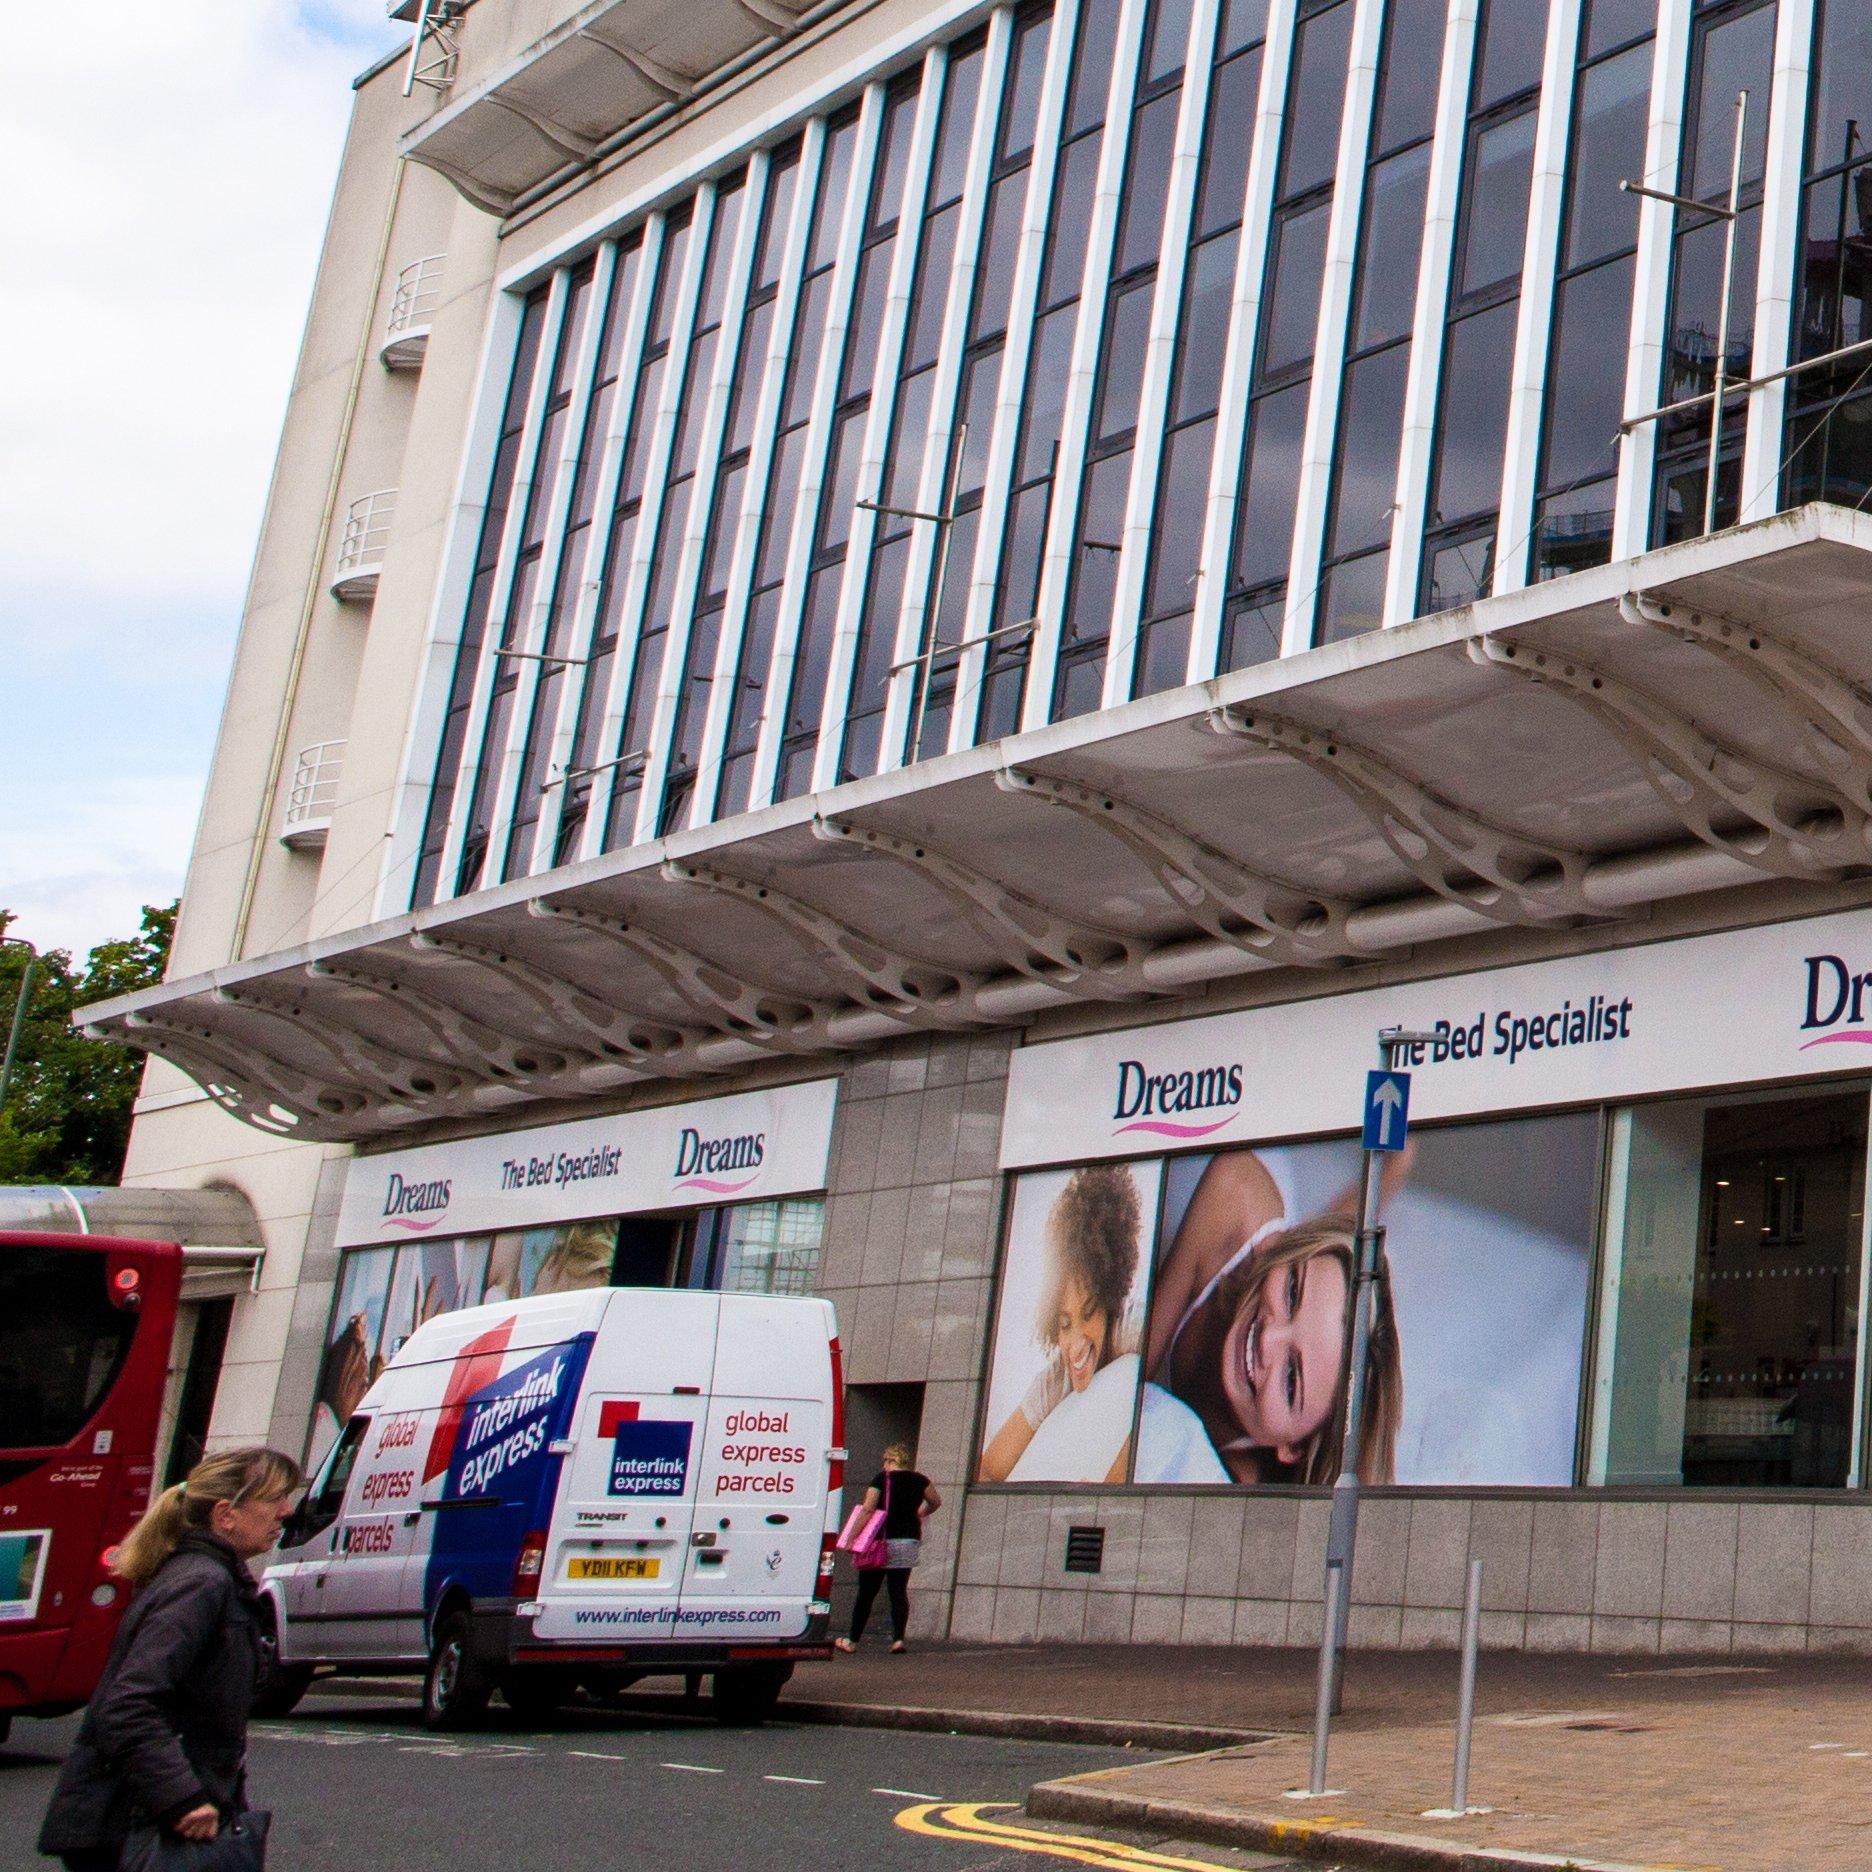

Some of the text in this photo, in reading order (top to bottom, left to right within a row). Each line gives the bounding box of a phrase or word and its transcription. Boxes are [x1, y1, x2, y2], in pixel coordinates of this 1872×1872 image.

[1385, 995, 1633, 1068] he Bed Specialist
[1114, 1060, 1243, 1120] Dreams
[382, 1127, 765, 1216] Dreams The Bed Specialist Dreams
[466, 1356, 564, 1450] interlink
[375, 1411, 423, 1459] global
[726, 1410, 789, 1436] global
[459, 1415, 548, 1496] express
[614, 1457, 685, 1474] interlink
[722, 1444, 805, 1466] express
[362, 1470, 414, 1509] express
[615, 1475, 681, 1493] express
[716, 1471, 795, 1497] parcels
[577, 1512, 628, 1521] TRANSIT
[345, 1515, 394, 1562] parcels
[616, 1559, 647, 1576] KFW
[576, 1606, 782, 1626] www.interlinkexpress.com
